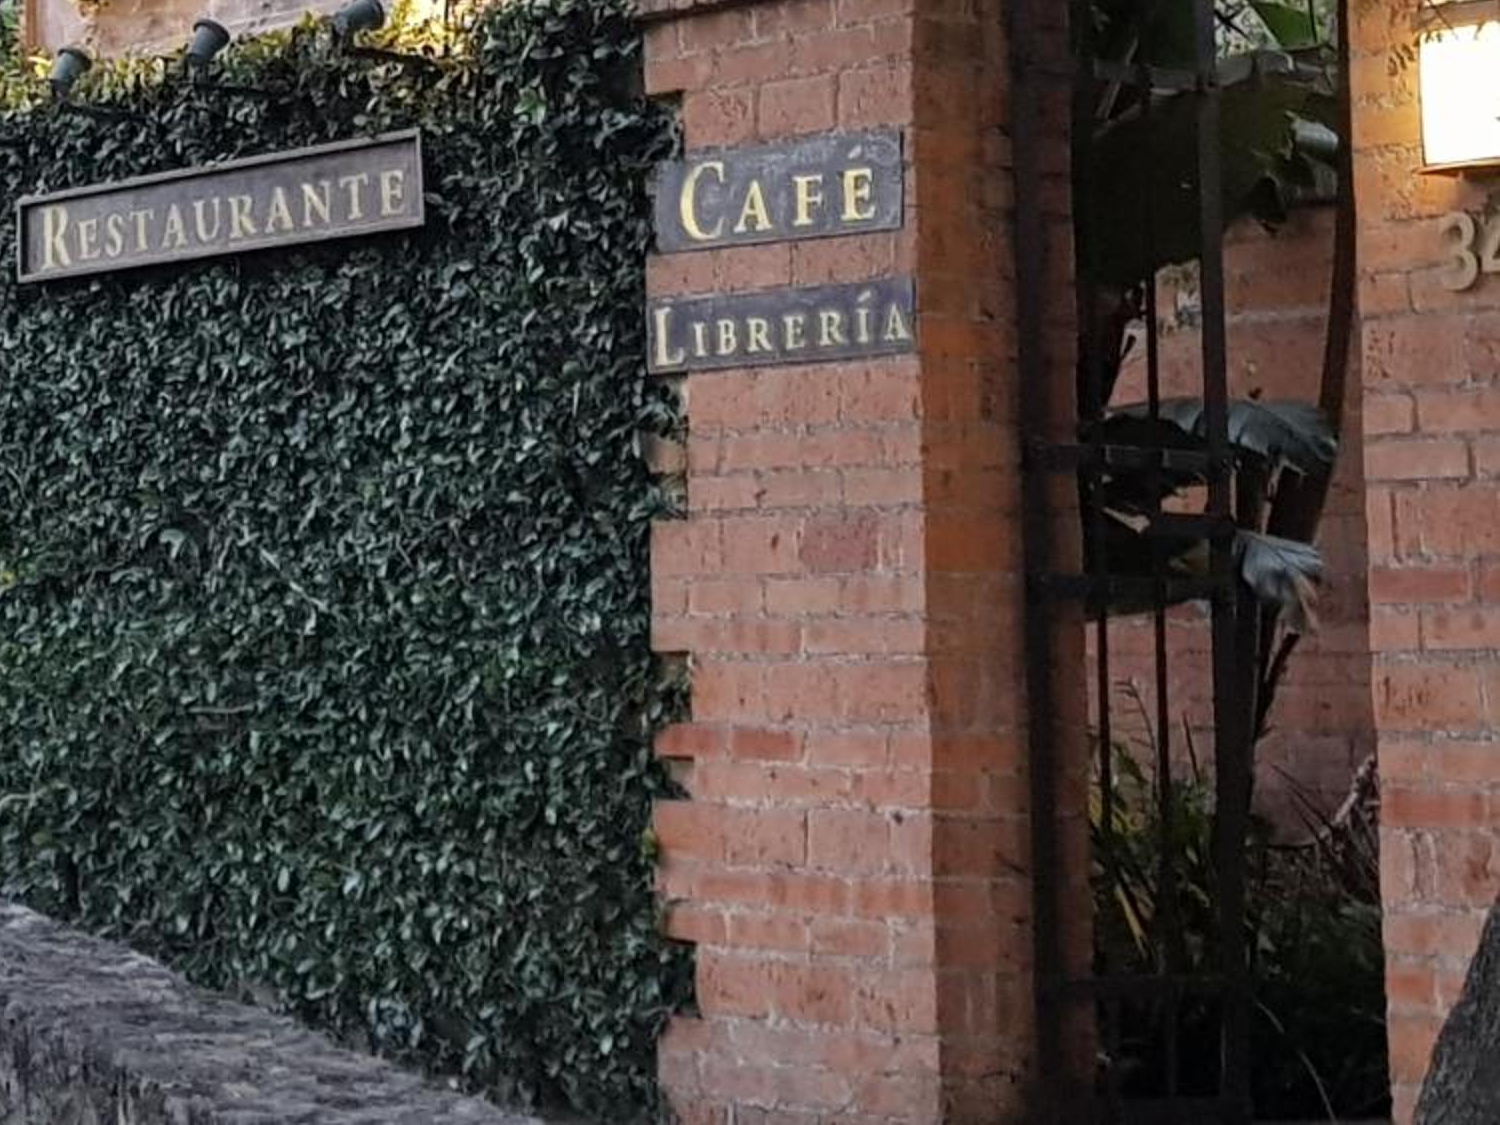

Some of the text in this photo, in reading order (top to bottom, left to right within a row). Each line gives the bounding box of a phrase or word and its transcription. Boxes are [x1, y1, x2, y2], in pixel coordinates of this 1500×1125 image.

[40, 169, 406, 271] RESTAURANTE
[679, 145, 877, 241] CAFÉ
[654, 290, 910, 366] LIBRERÍA
